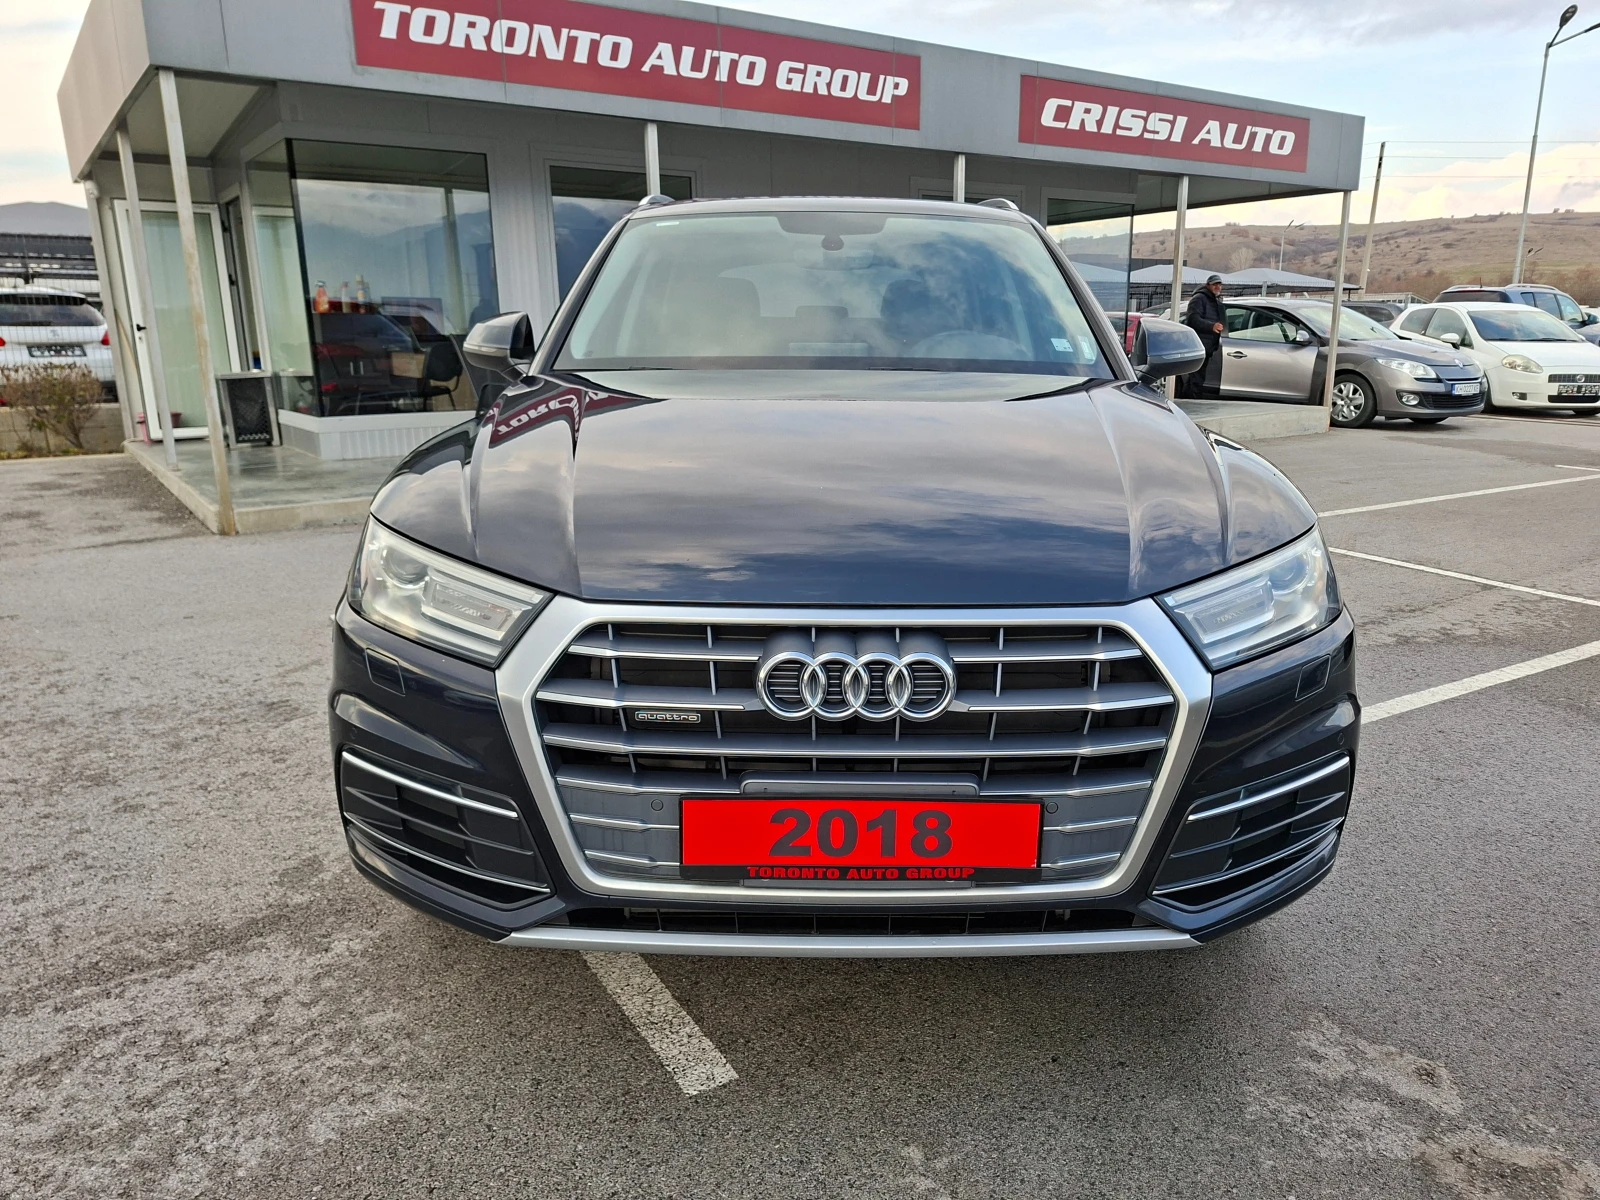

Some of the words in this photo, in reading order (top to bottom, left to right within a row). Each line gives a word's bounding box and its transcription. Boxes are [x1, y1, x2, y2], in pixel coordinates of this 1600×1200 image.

[373, 0, 634, 69] TORONTO
[640, 41, 767, 87] AUTO
[775, 60, 909, 104] GROUP
[1040, 97, 1189, 143] CRISSI
[1191, 119, 1296, 156] AUTO
[637, 713, 698, 721] quattro
[769, 808, 954, 858] 2018
[747, 866, 841, 880] TORONTO
[846, 867, 899, 880] AUTO
[905, 866, 975, 880] GROUP
